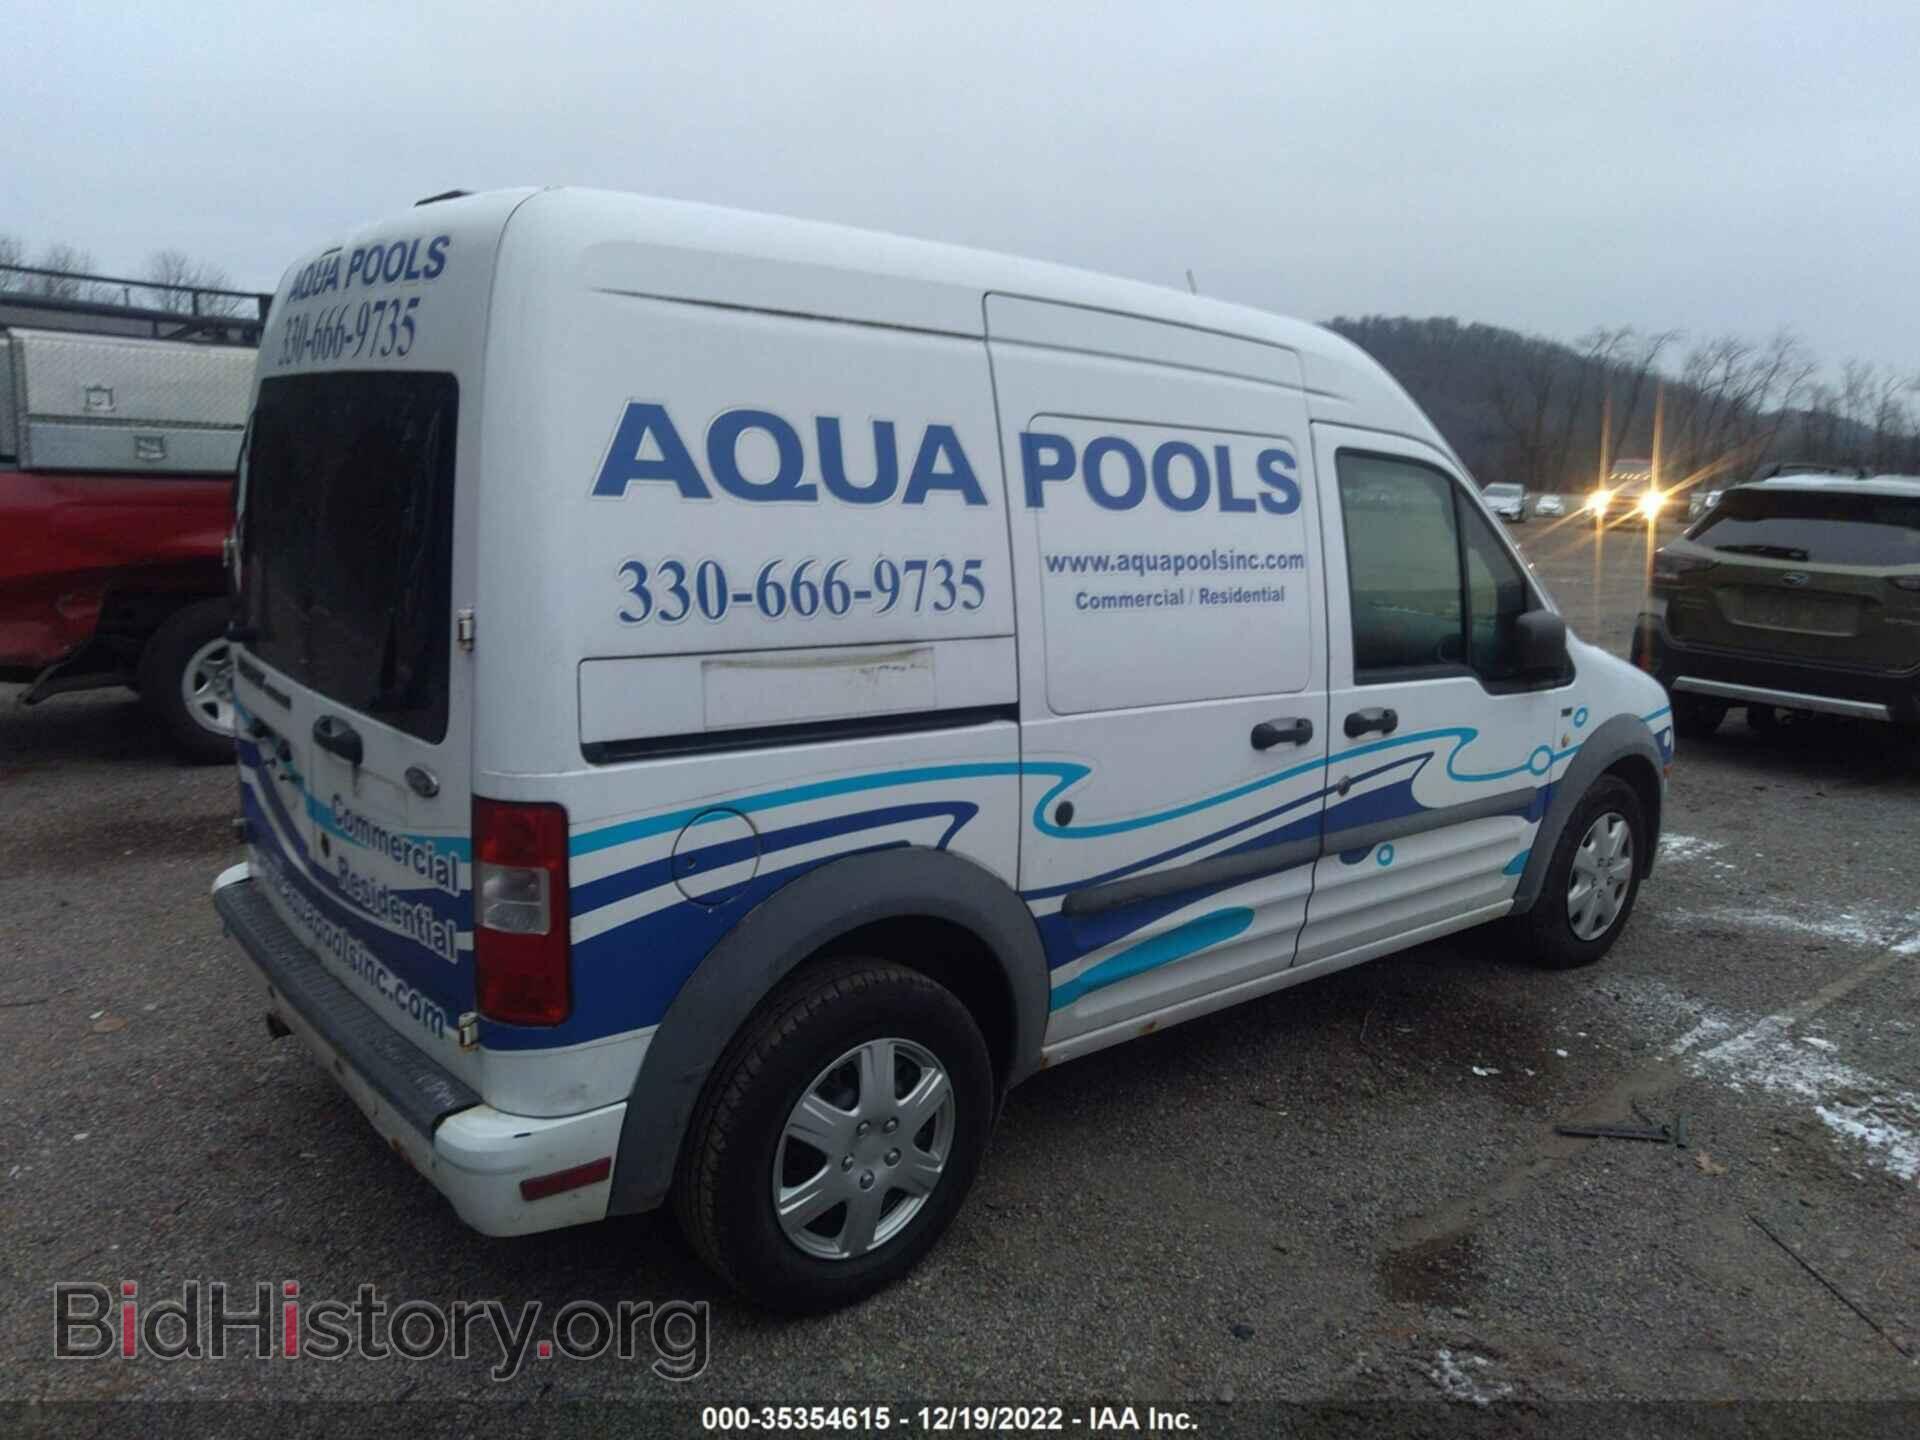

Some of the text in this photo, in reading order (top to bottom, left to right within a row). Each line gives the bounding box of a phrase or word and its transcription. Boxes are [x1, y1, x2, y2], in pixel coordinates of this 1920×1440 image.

[287, 235, 450, 303] AQUA POOLS
[591, 398, 1302, 515] AQUA POOLS
[616, 557, 986, 624] 330-666-9735
[1045, 549, 1305, 577] www.aquapoolsinc.com
[1075, 588, 1185, 611] Commercial
[1199, 585, 1286, 606] Residential
[333, 794, 459, 896] Commercial
[336, 856, 459, 964] Residential
